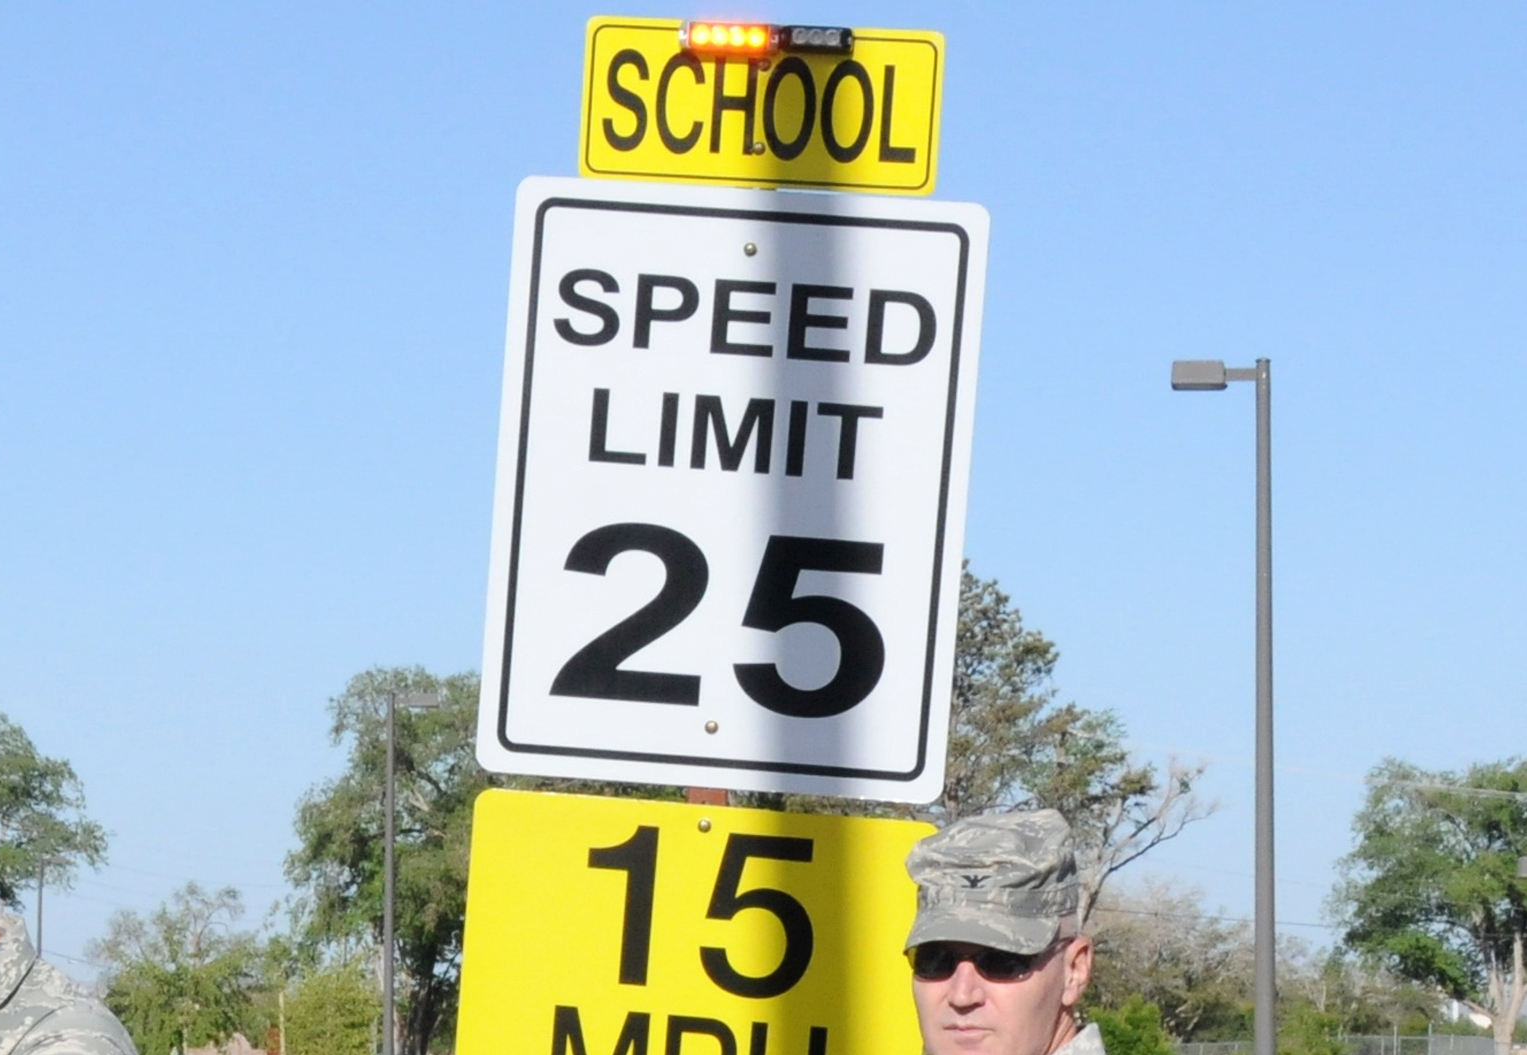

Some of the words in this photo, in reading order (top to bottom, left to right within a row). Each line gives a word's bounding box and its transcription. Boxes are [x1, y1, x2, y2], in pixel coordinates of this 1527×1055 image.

[602, 48, 916, 163] SCHOOL
[553, 269, 937, 366] SPEED
[588, 388, 883, 480] LIMIT
[549, 522, 886, 718] 25
[587, 825, 814, 999] 15
